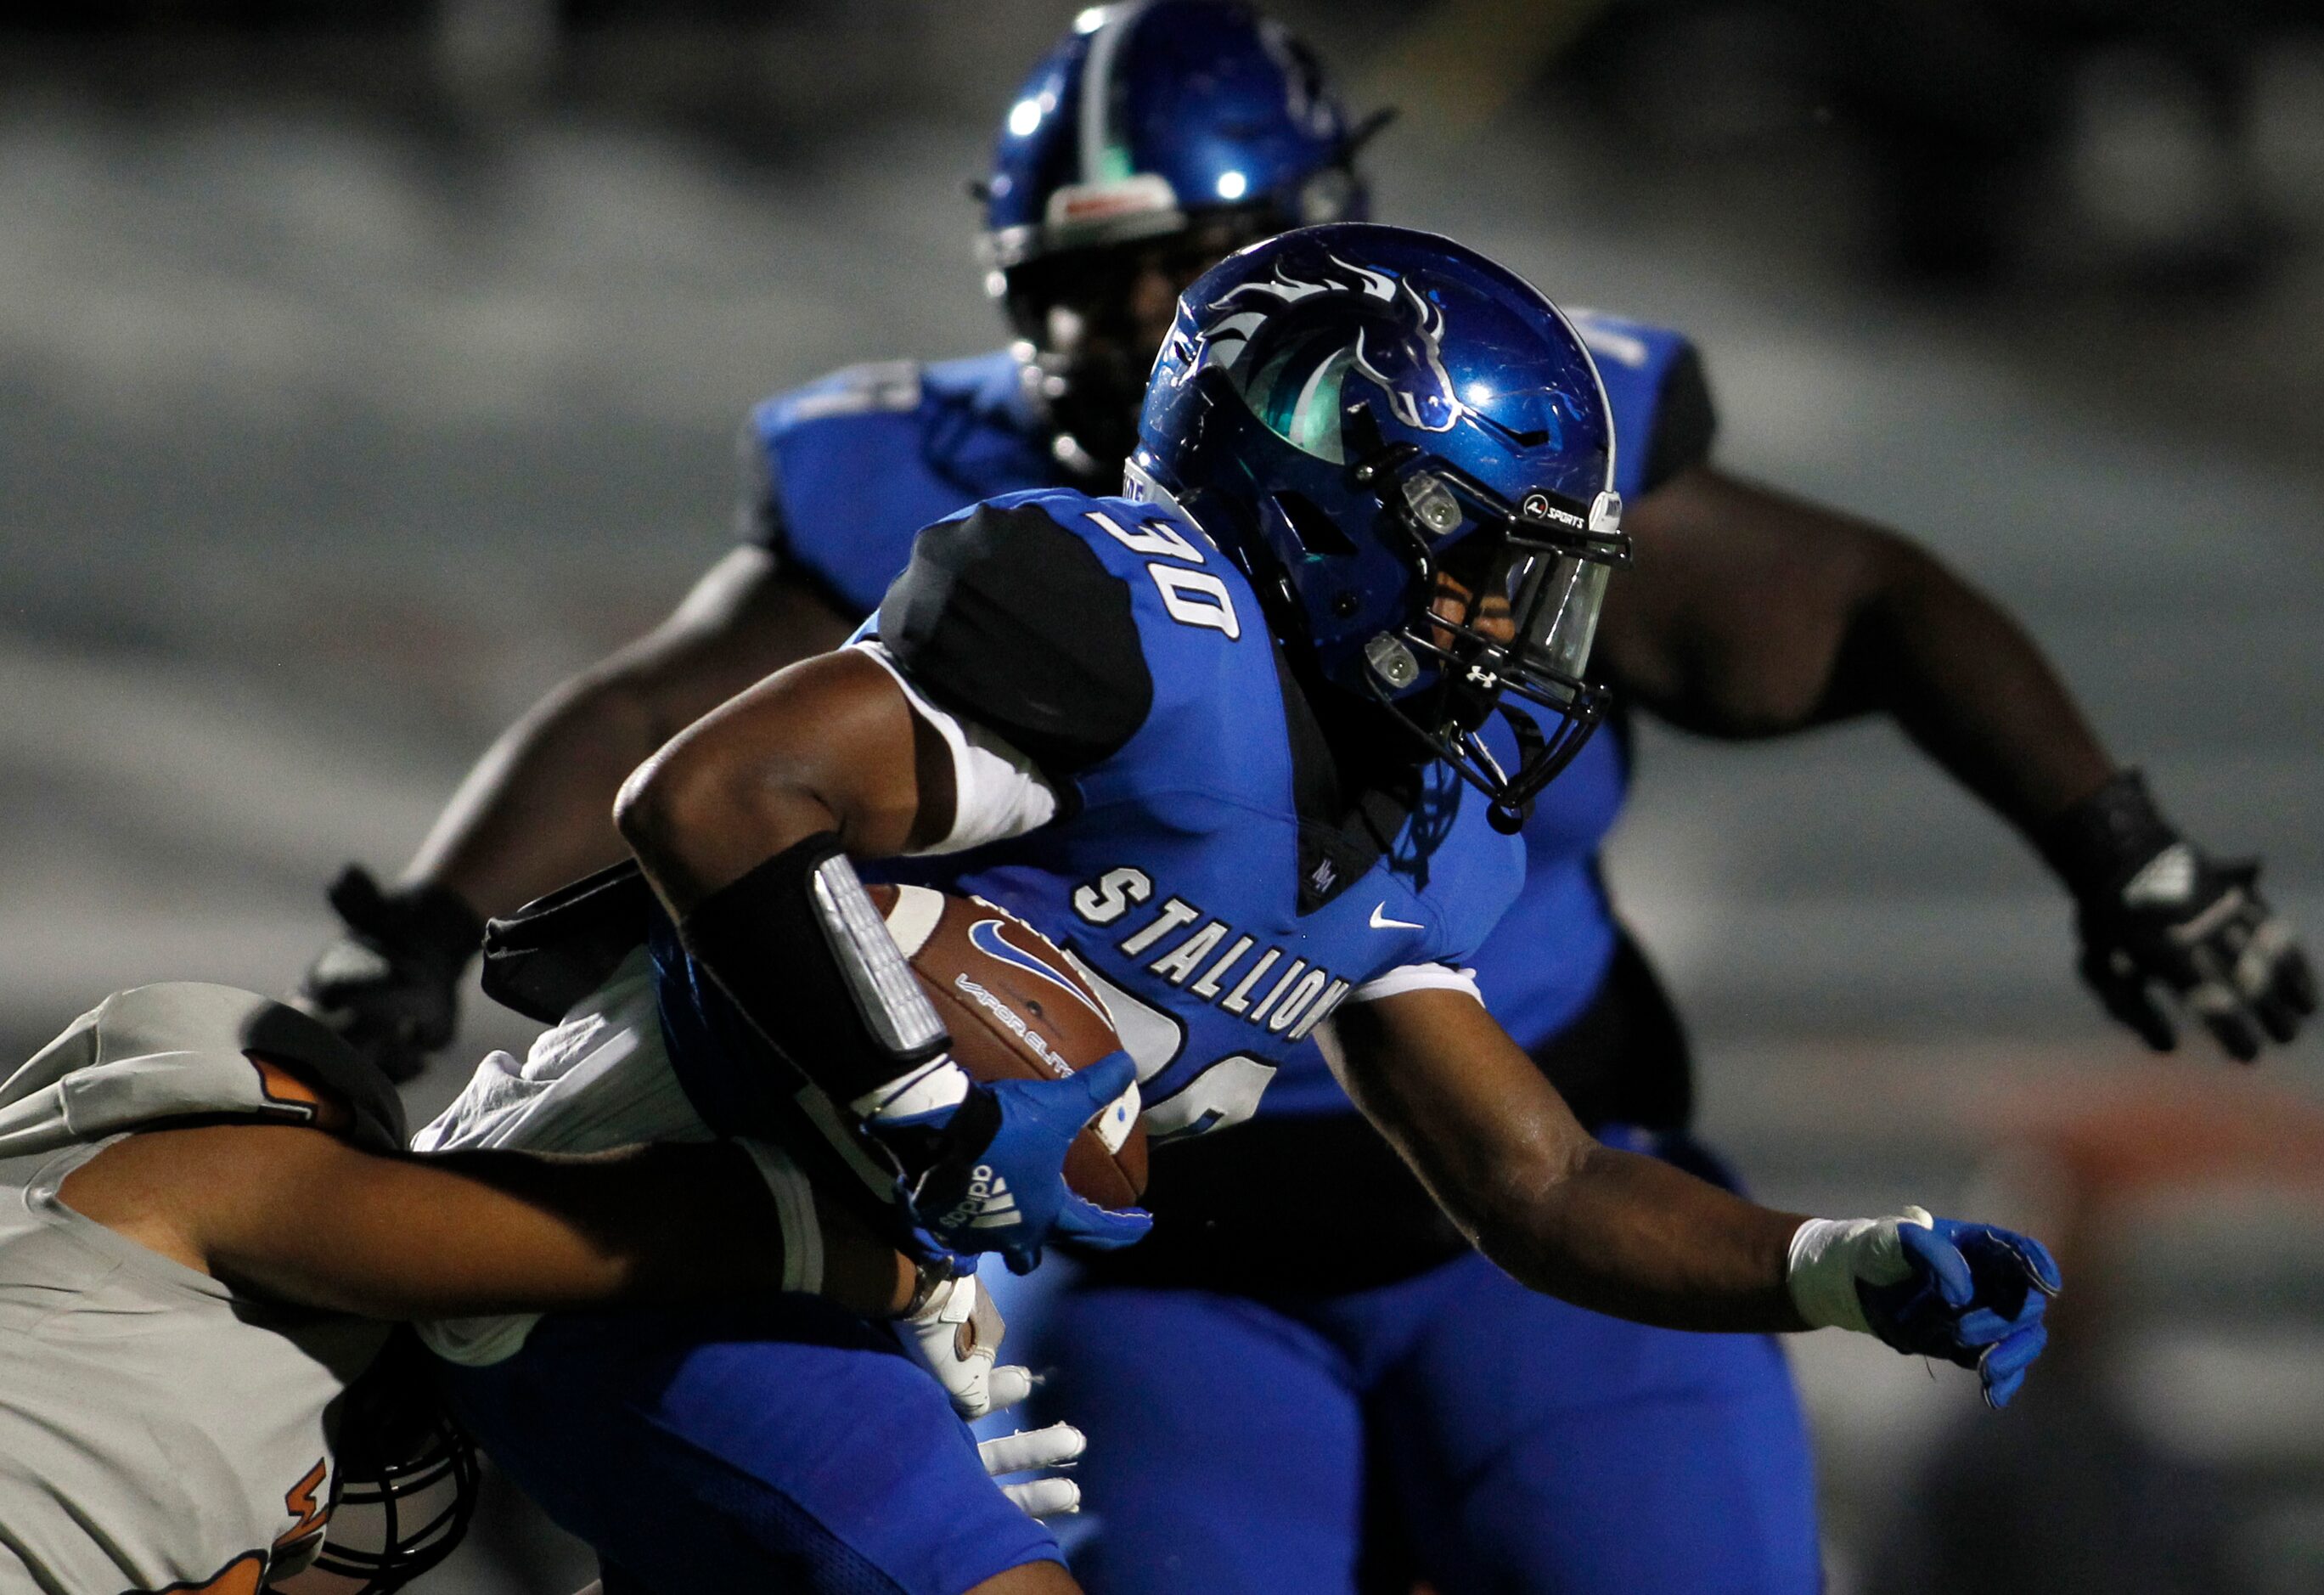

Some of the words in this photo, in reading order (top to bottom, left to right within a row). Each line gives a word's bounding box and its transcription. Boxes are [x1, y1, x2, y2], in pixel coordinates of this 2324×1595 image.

[1547, 507, 1584, 529] SPORTS
[1082, 511, 1240, 639] 30
[1073, 867, 1350, 1040] STALLION
[954, 972, 1027, 1029] VAPOR
[939, 1164, 993, 1228] adidas
